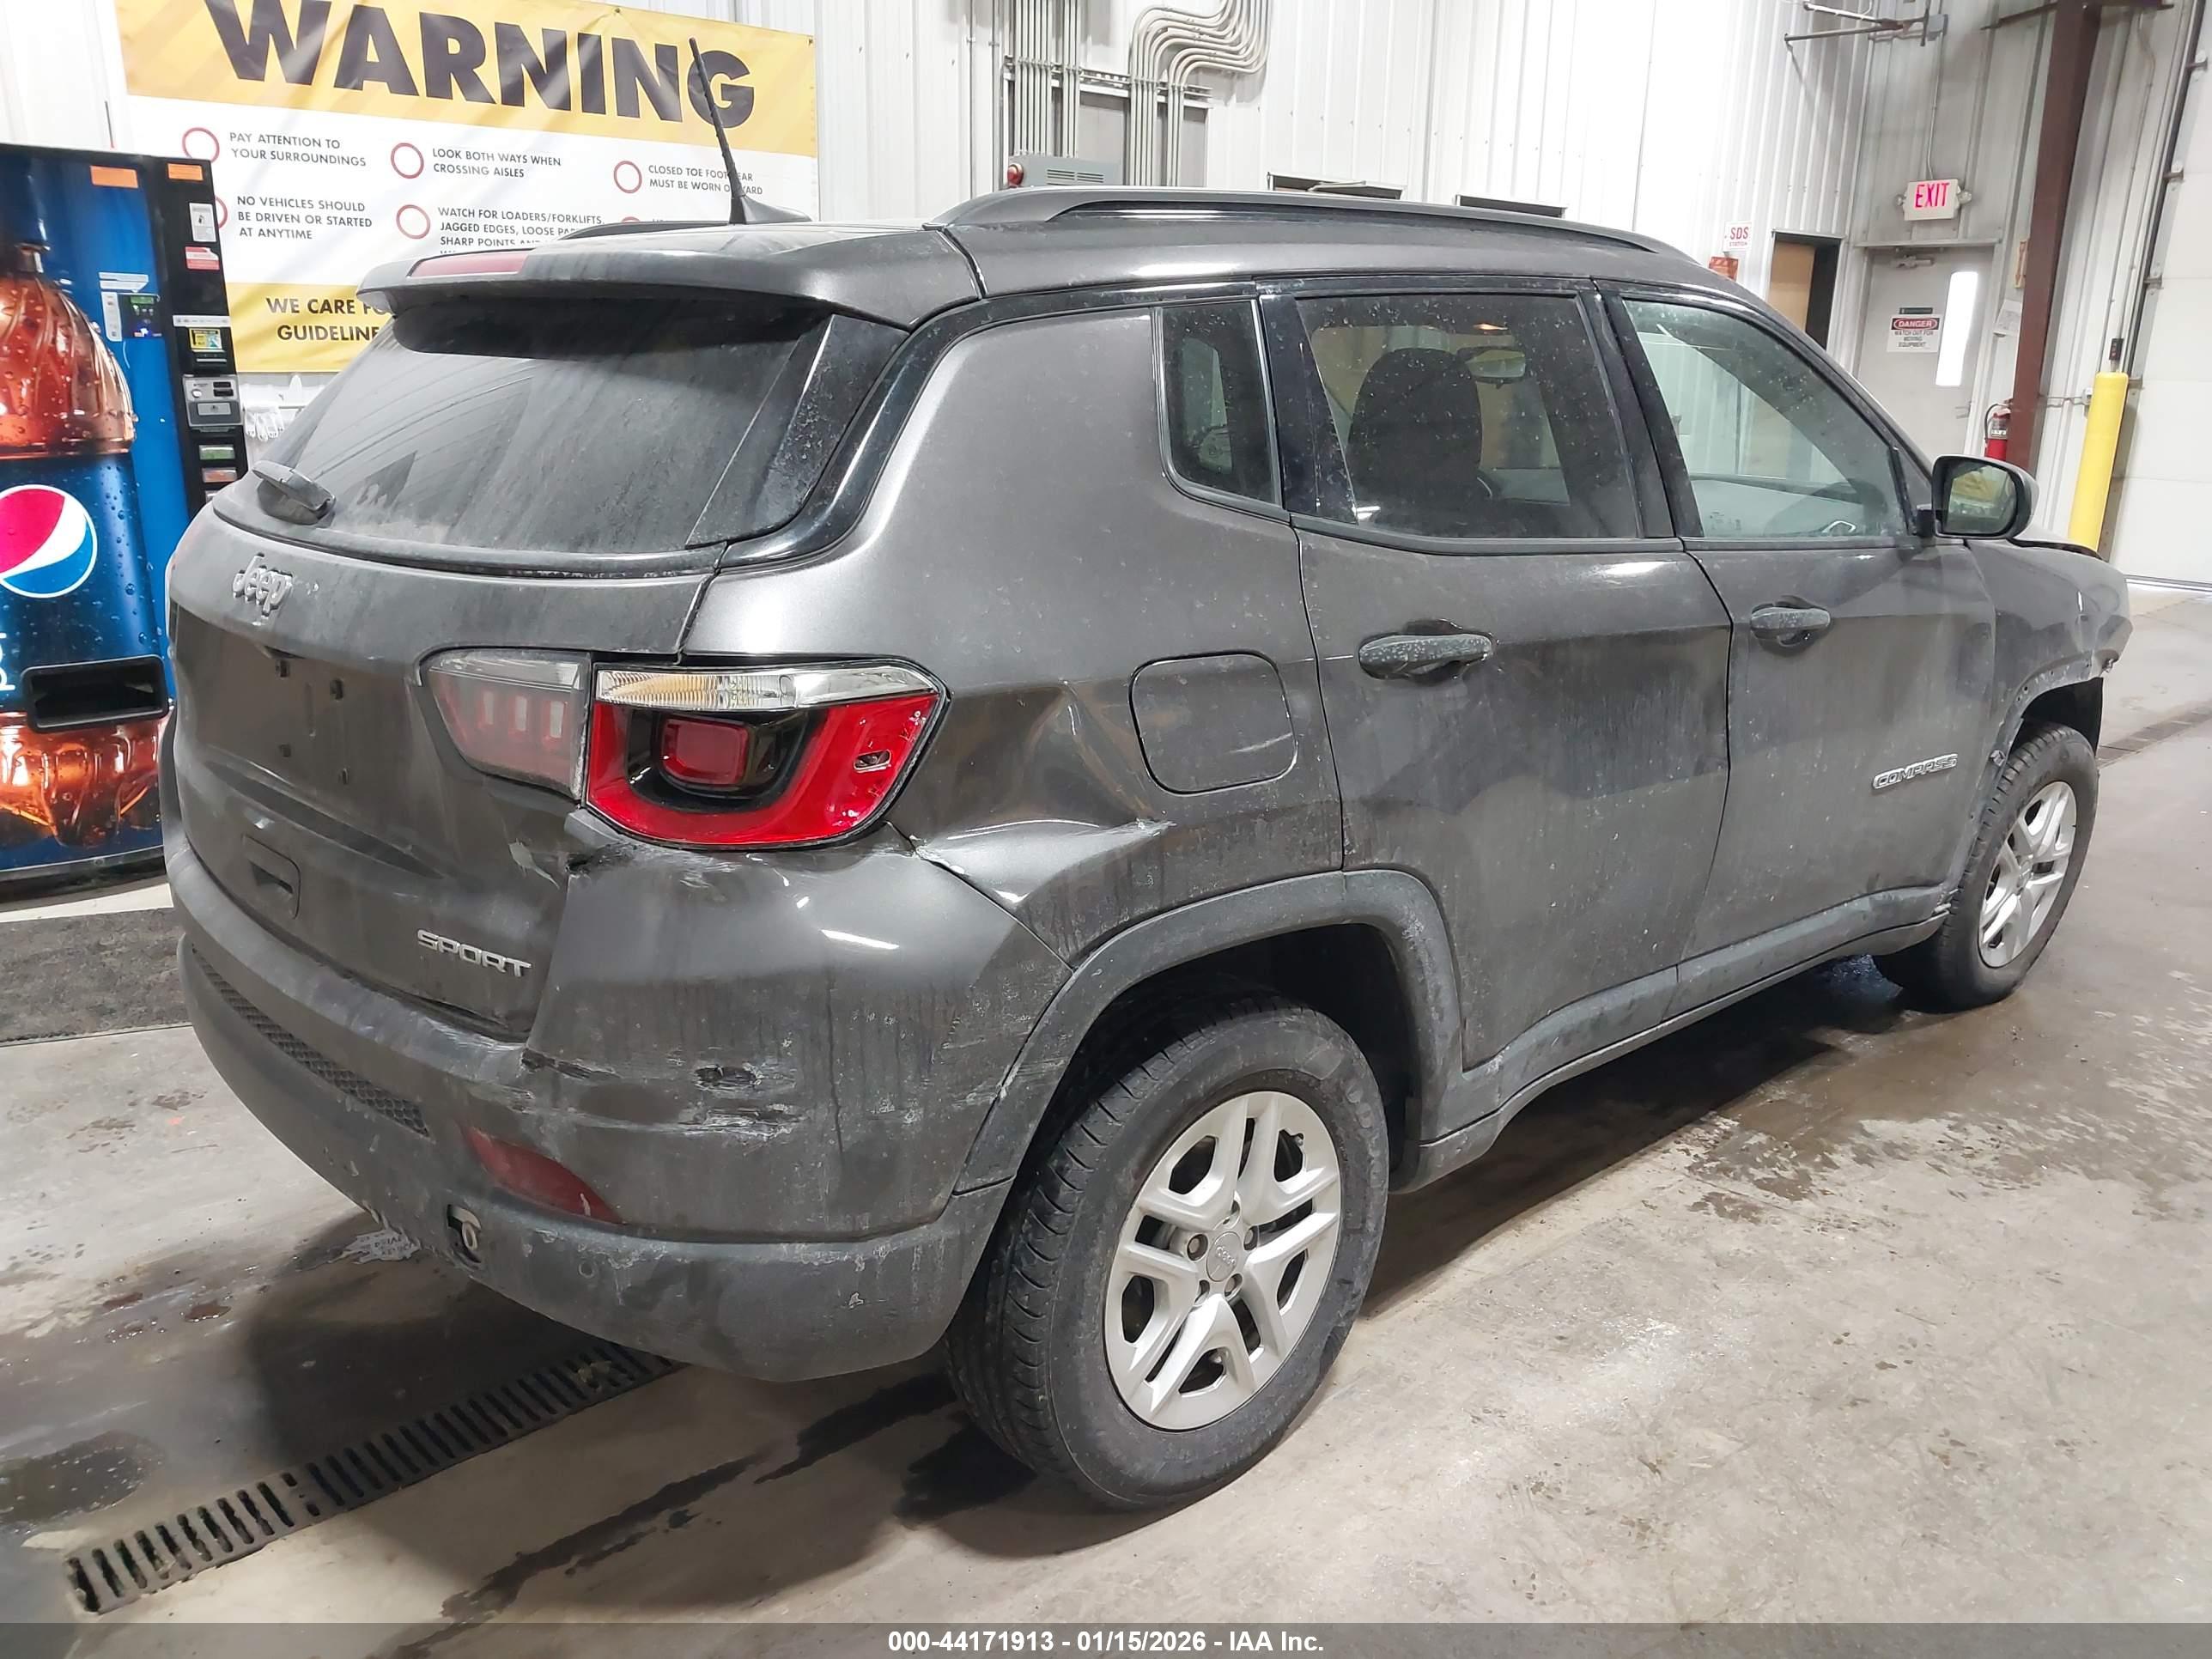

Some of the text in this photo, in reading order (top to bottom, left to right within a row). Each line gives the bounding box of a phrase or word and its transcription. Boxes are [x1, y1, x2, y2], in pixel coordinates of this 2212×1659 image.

[204, 0, 756, 129] WARNING
[229, 132, 341, 149] PAY ATTENTION TO
[231, 148, 367, 167] YOUR SURROUNDINGS
[433, 148, 561, 167] LOOK BOTH WAYS WHEN
[434, 163, 525, 178] CROSSING AISLES
[648, 165, 753, 182] CLOSED TOE FOOTEAR
[649, 179, 675, 189] MUST
[678, 180, 688, 190] BE
[691, 181, 721, 192] WORN
[1915, 182, 1950, 208] EXIT
[237, 196, 365, 212] NO VEHICLES SHOULD
[238, 211, 373, 228] BE DRIVEN OR STARTED
[438, 207, 475, 218] WATCH
[478, 209, 498, 219] FOR
[240, 228, 313, 240] AT ANYTIME
[440, 222, 480, 233] JAGGED
[483, 223, 520, 235] EDGES,
[522, 226, 556, 235] LOOSE
[1729, 226, 1749, 240] SDS
[440, 236, 478, 246] SHARP
[478, 238, 515, 247] POINTS
[266, 298, 301, 313] WE
[307, 299, 355, 314] CARE
[233, 556, 293, 615] Jeep
[1872, 753, 1959, 789] COMPASS
[417, 928, 532, 977] SPORT
